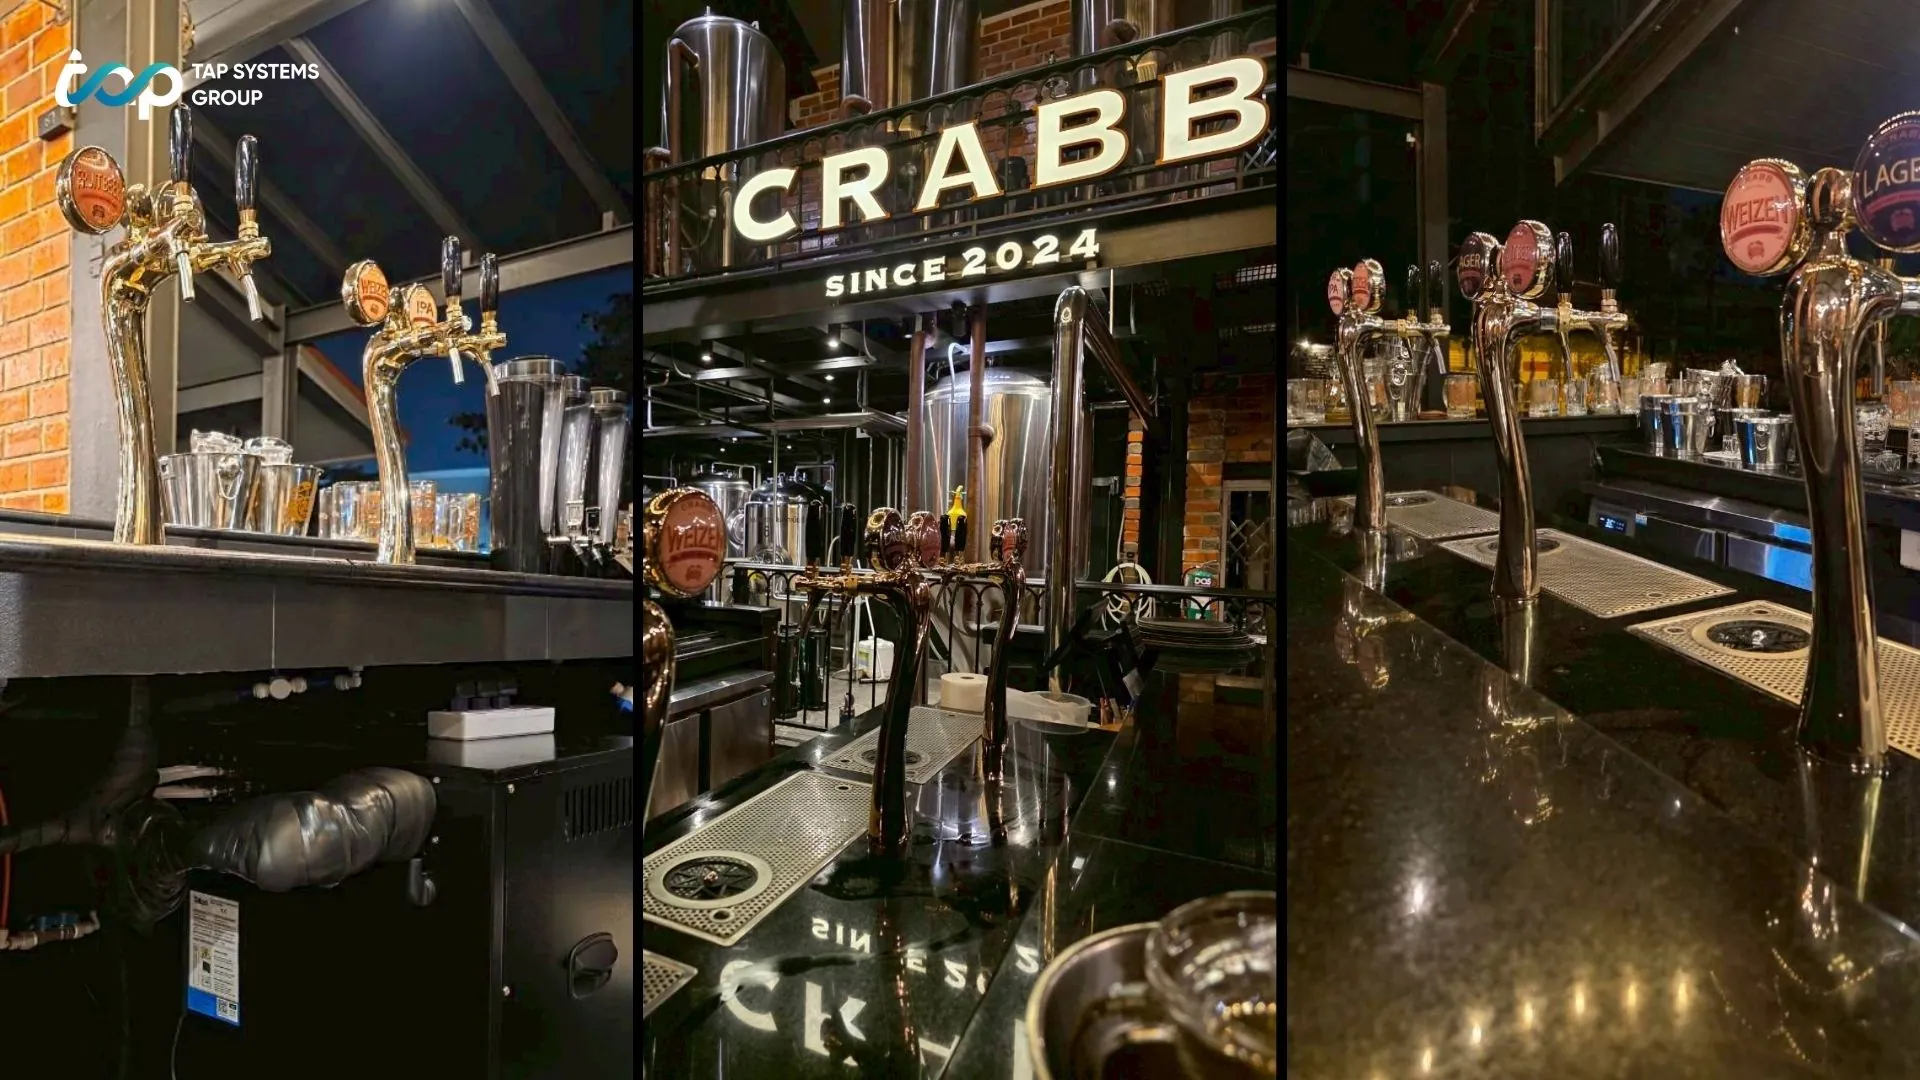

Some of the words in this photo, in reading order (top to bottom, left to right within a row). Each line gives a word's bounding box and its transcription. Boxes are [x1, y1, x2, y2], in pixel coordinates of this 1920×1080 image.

[733, 55, 1271, 243] CRABB
[825, 256, 947, 298] SINCE
[961, 227, 1101, 278] 2024
[416, 301, 434, 318] IPA
